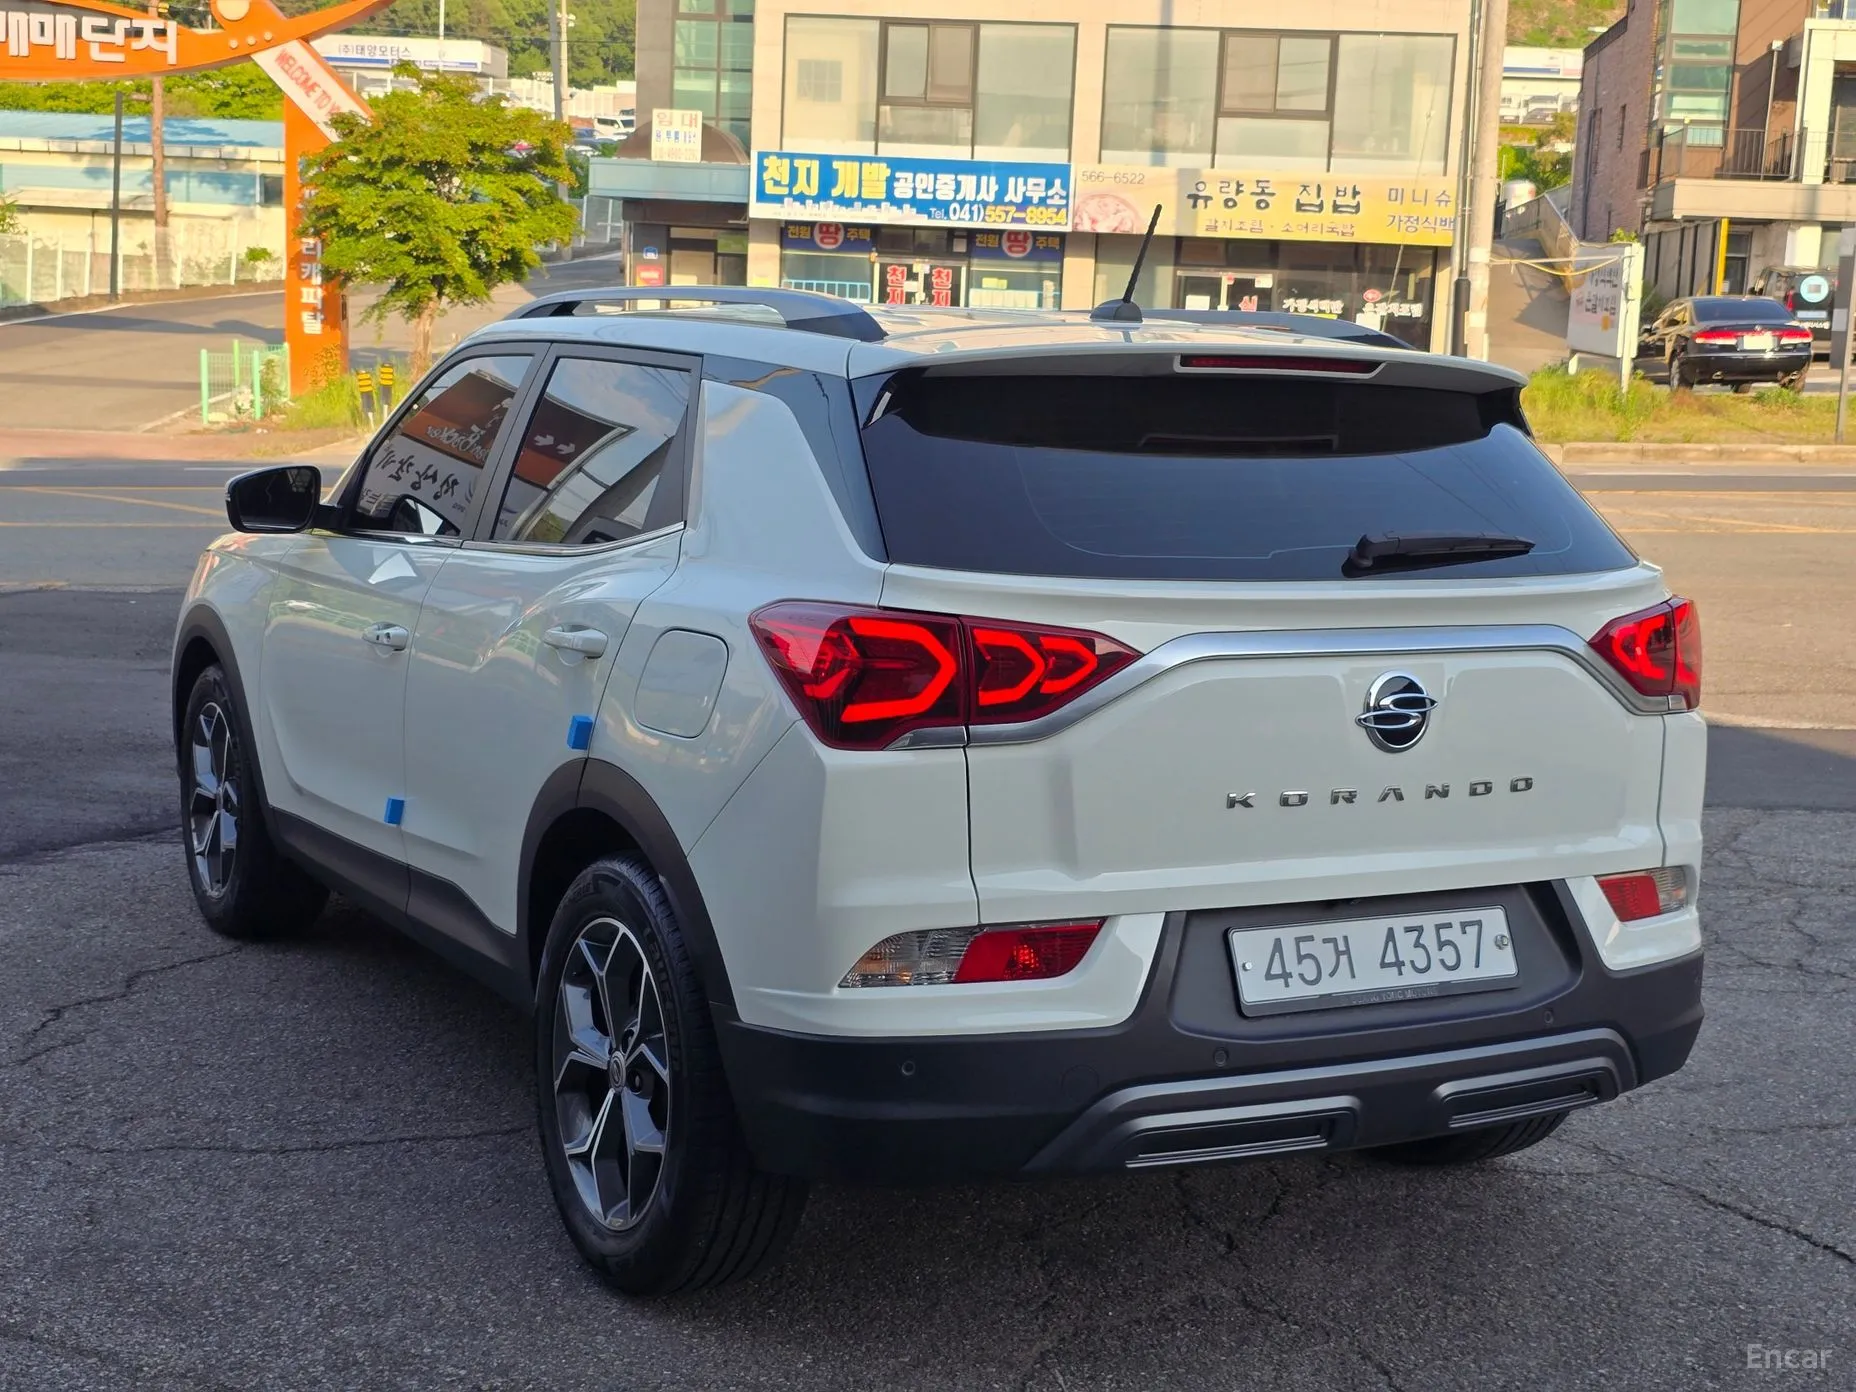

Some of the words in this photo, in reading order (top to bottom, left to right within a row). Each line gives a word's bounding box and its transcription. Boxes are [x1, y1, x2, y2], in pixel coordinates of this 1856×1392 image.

[338, 43, 411, 59] (주)태양모터스
[275, 49, 321, 98] WELCOME
[314, 89, 332, 110] TO
[763, 155, 819, 197] 천지
[831, 160, 891, 199] 개발
[893, 171, 999, 202] 공인중개사
[1004, 176, 1067, 205] 사무소
[1081, 171, 1145, 185] 566-6522
[1187, 179, 1276, 211] 유량동
[1296, 183, 1361, 215] 집밥
[1204, 218, 1263, 234] 갈치조림
[1226, 776, 1534, 809] KORANDO
[1264, 934, 1357, 988] 45거
[1379, 918, 1483, 977] 4357
